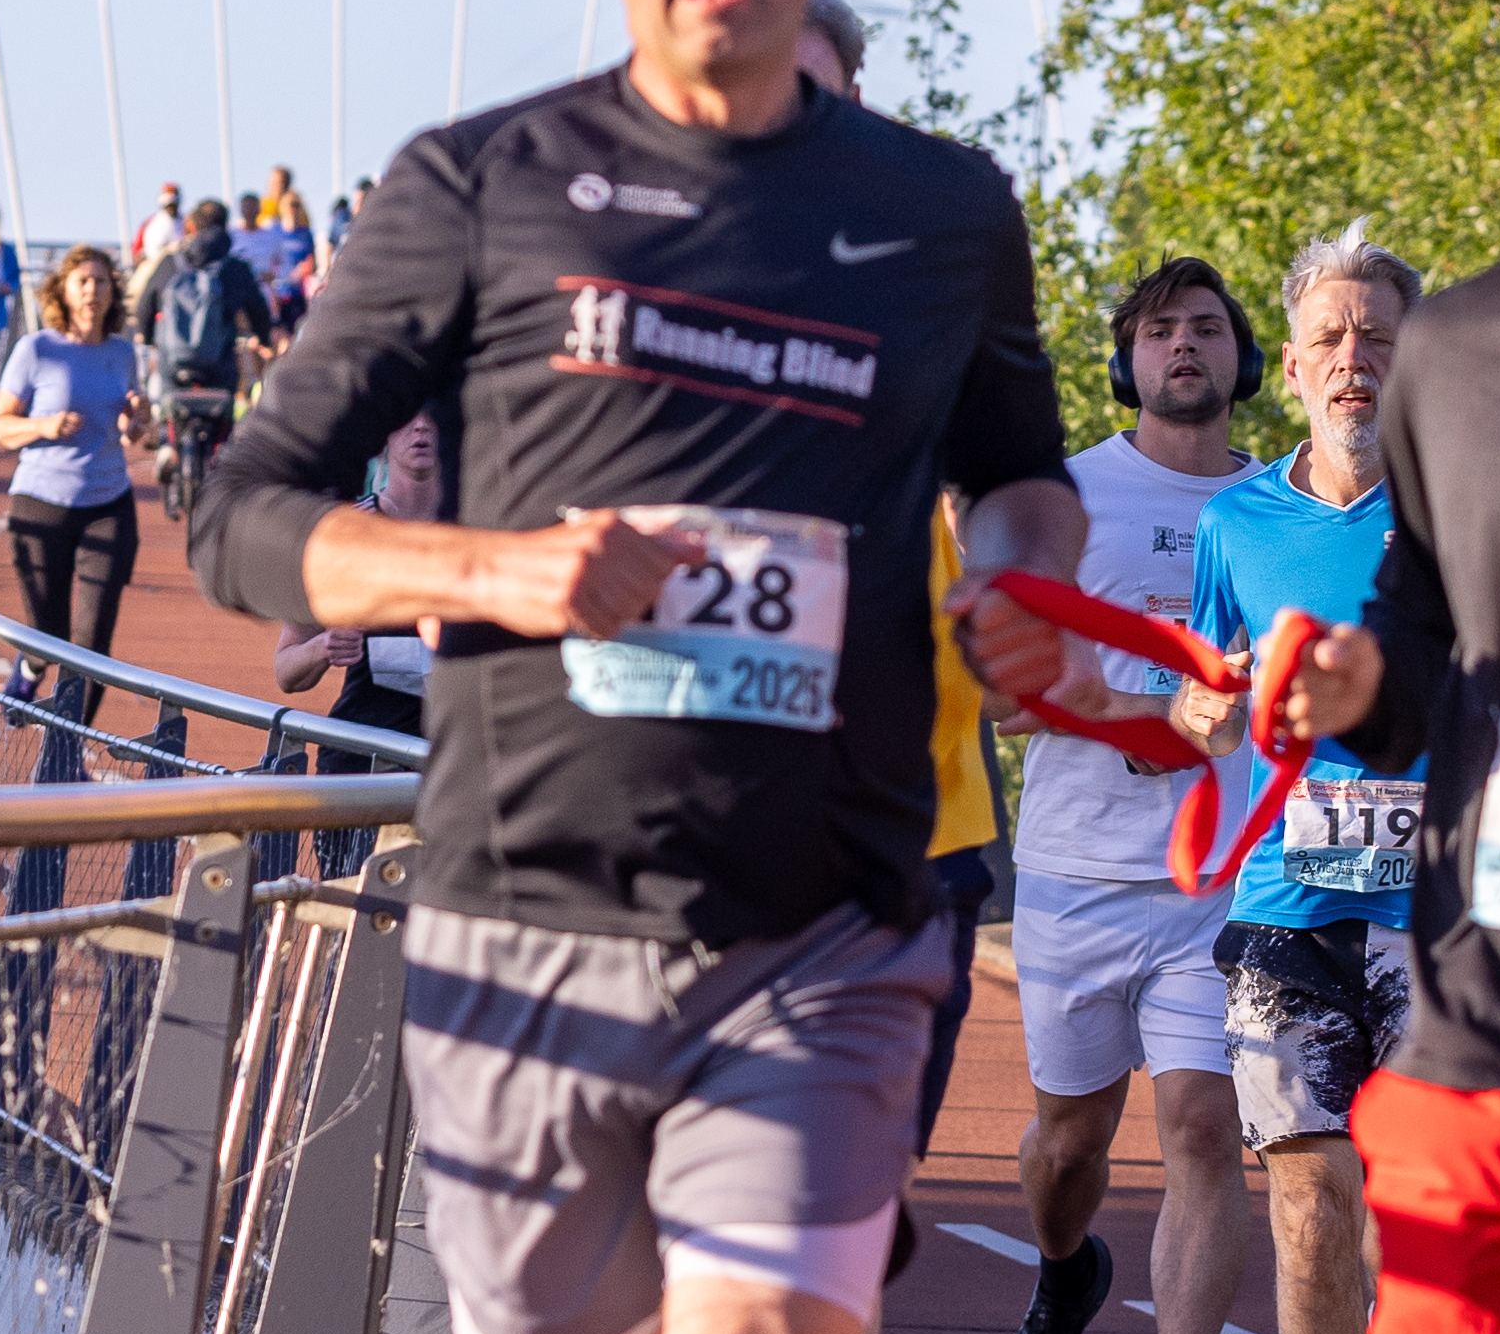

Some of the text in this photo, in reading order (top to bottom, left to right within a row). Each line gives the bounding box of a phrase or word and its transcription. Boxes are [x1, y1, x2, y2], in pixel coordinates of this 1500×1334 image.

[632, 305, 877, 399] Running Blind
[640, 561, 794, 633] 28
[1323, 806, 1420, 848] 119
[1377, 857, 1418, 887] 202
